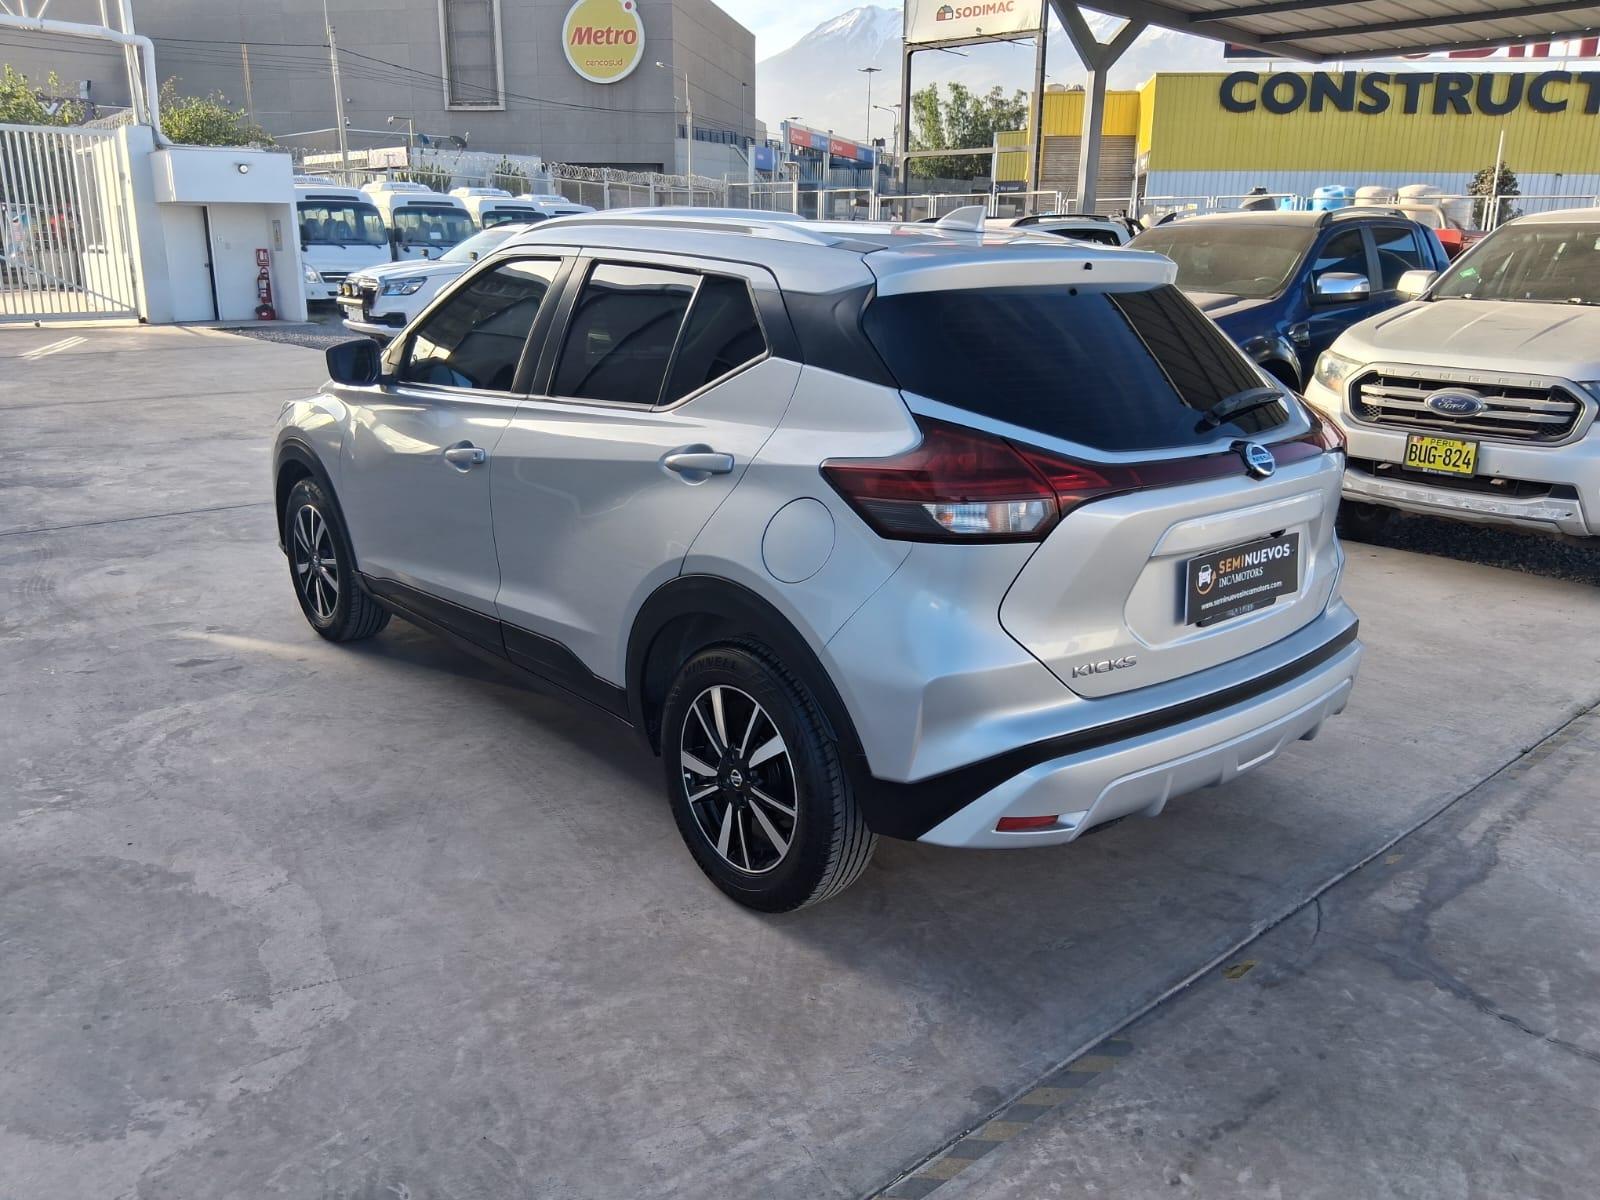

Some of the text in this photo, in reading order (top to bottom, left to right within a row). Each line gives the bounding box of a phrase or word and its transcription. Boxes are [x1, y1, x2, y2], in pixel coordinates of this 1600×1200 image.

[955, 0, 1015, 19] SODIMAC
[571, 26, 637, 45] Metro
[585, 59, 623, 67] cencosud
[1219, 70, 1600, 115] CONSTRUCT
[1437, 397, 1467, 411] Ford
[1430, 438, 1455, 448] PERU
[1408, 443, 1471, 470] BUG-824
[1219, 544, 1290, 573] SEMINUEVOS
[1219, 566, 1264, 588] INCAMOTORS
[1072, 655, 1137, 679] KICKS
